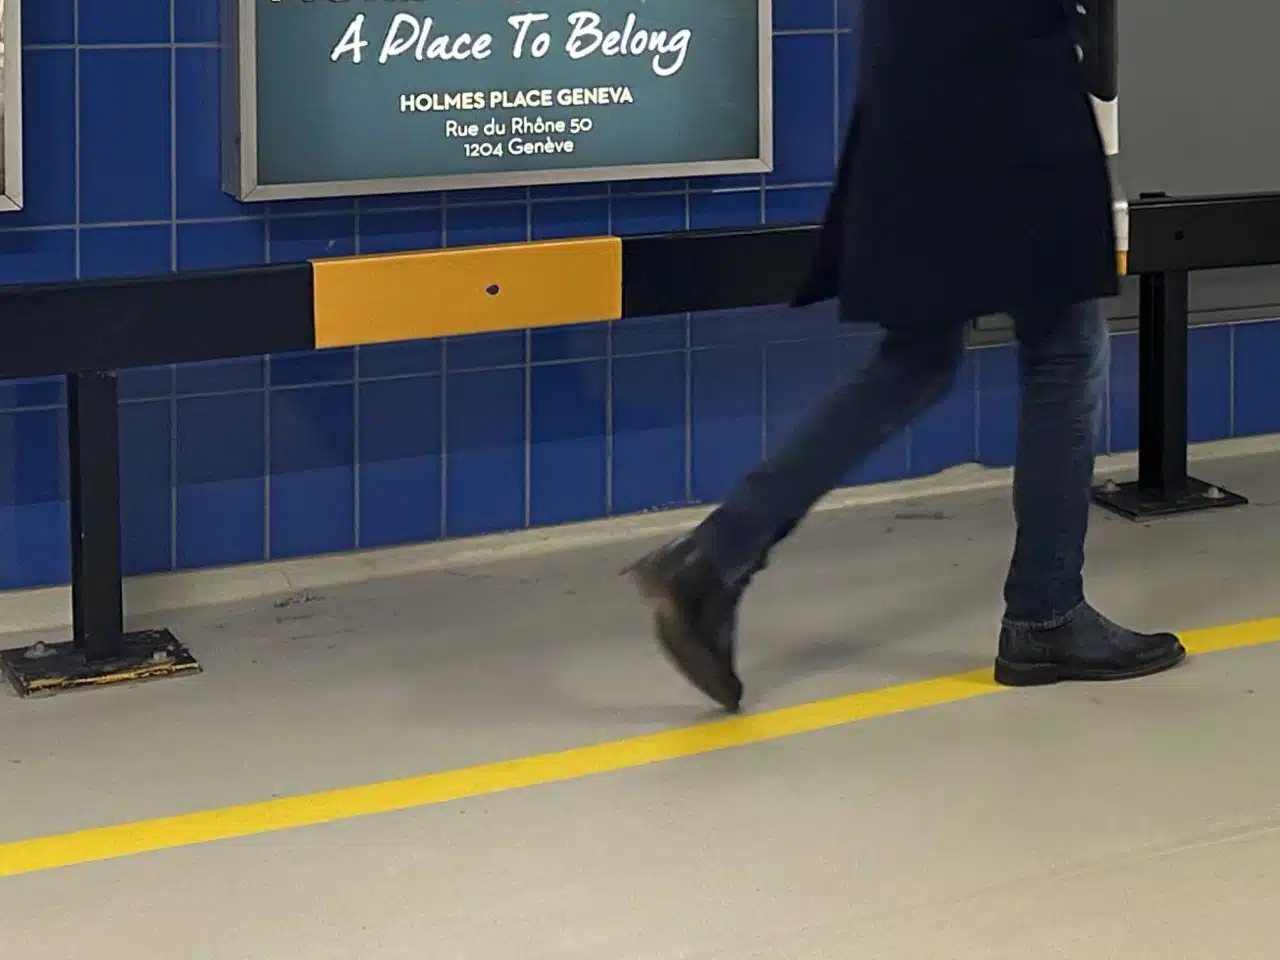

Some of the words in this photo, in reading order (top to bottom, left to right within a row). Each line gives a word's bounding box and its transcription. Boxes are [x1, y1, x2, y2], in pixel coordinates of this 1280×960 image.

[330, 13, 369, 64] A
[378, 12, 493, 65] Place
[507, 12, 551, 59] To
[565, 10, 692, 77] Belong
[400, 92, 486, 113] HOLMES
[490, 89, 554, 109] PLACE
[557, 86, 634, 106] GENEVA
[445, 119, 480, 138] Rue
[483, 117, 506, 136] du
[511, 115, 566, 135] Rhône
[570, 118, 593, 134] 50
[464, 143, 503, 157] 1204
[508, 136, 575, 156] Genève
